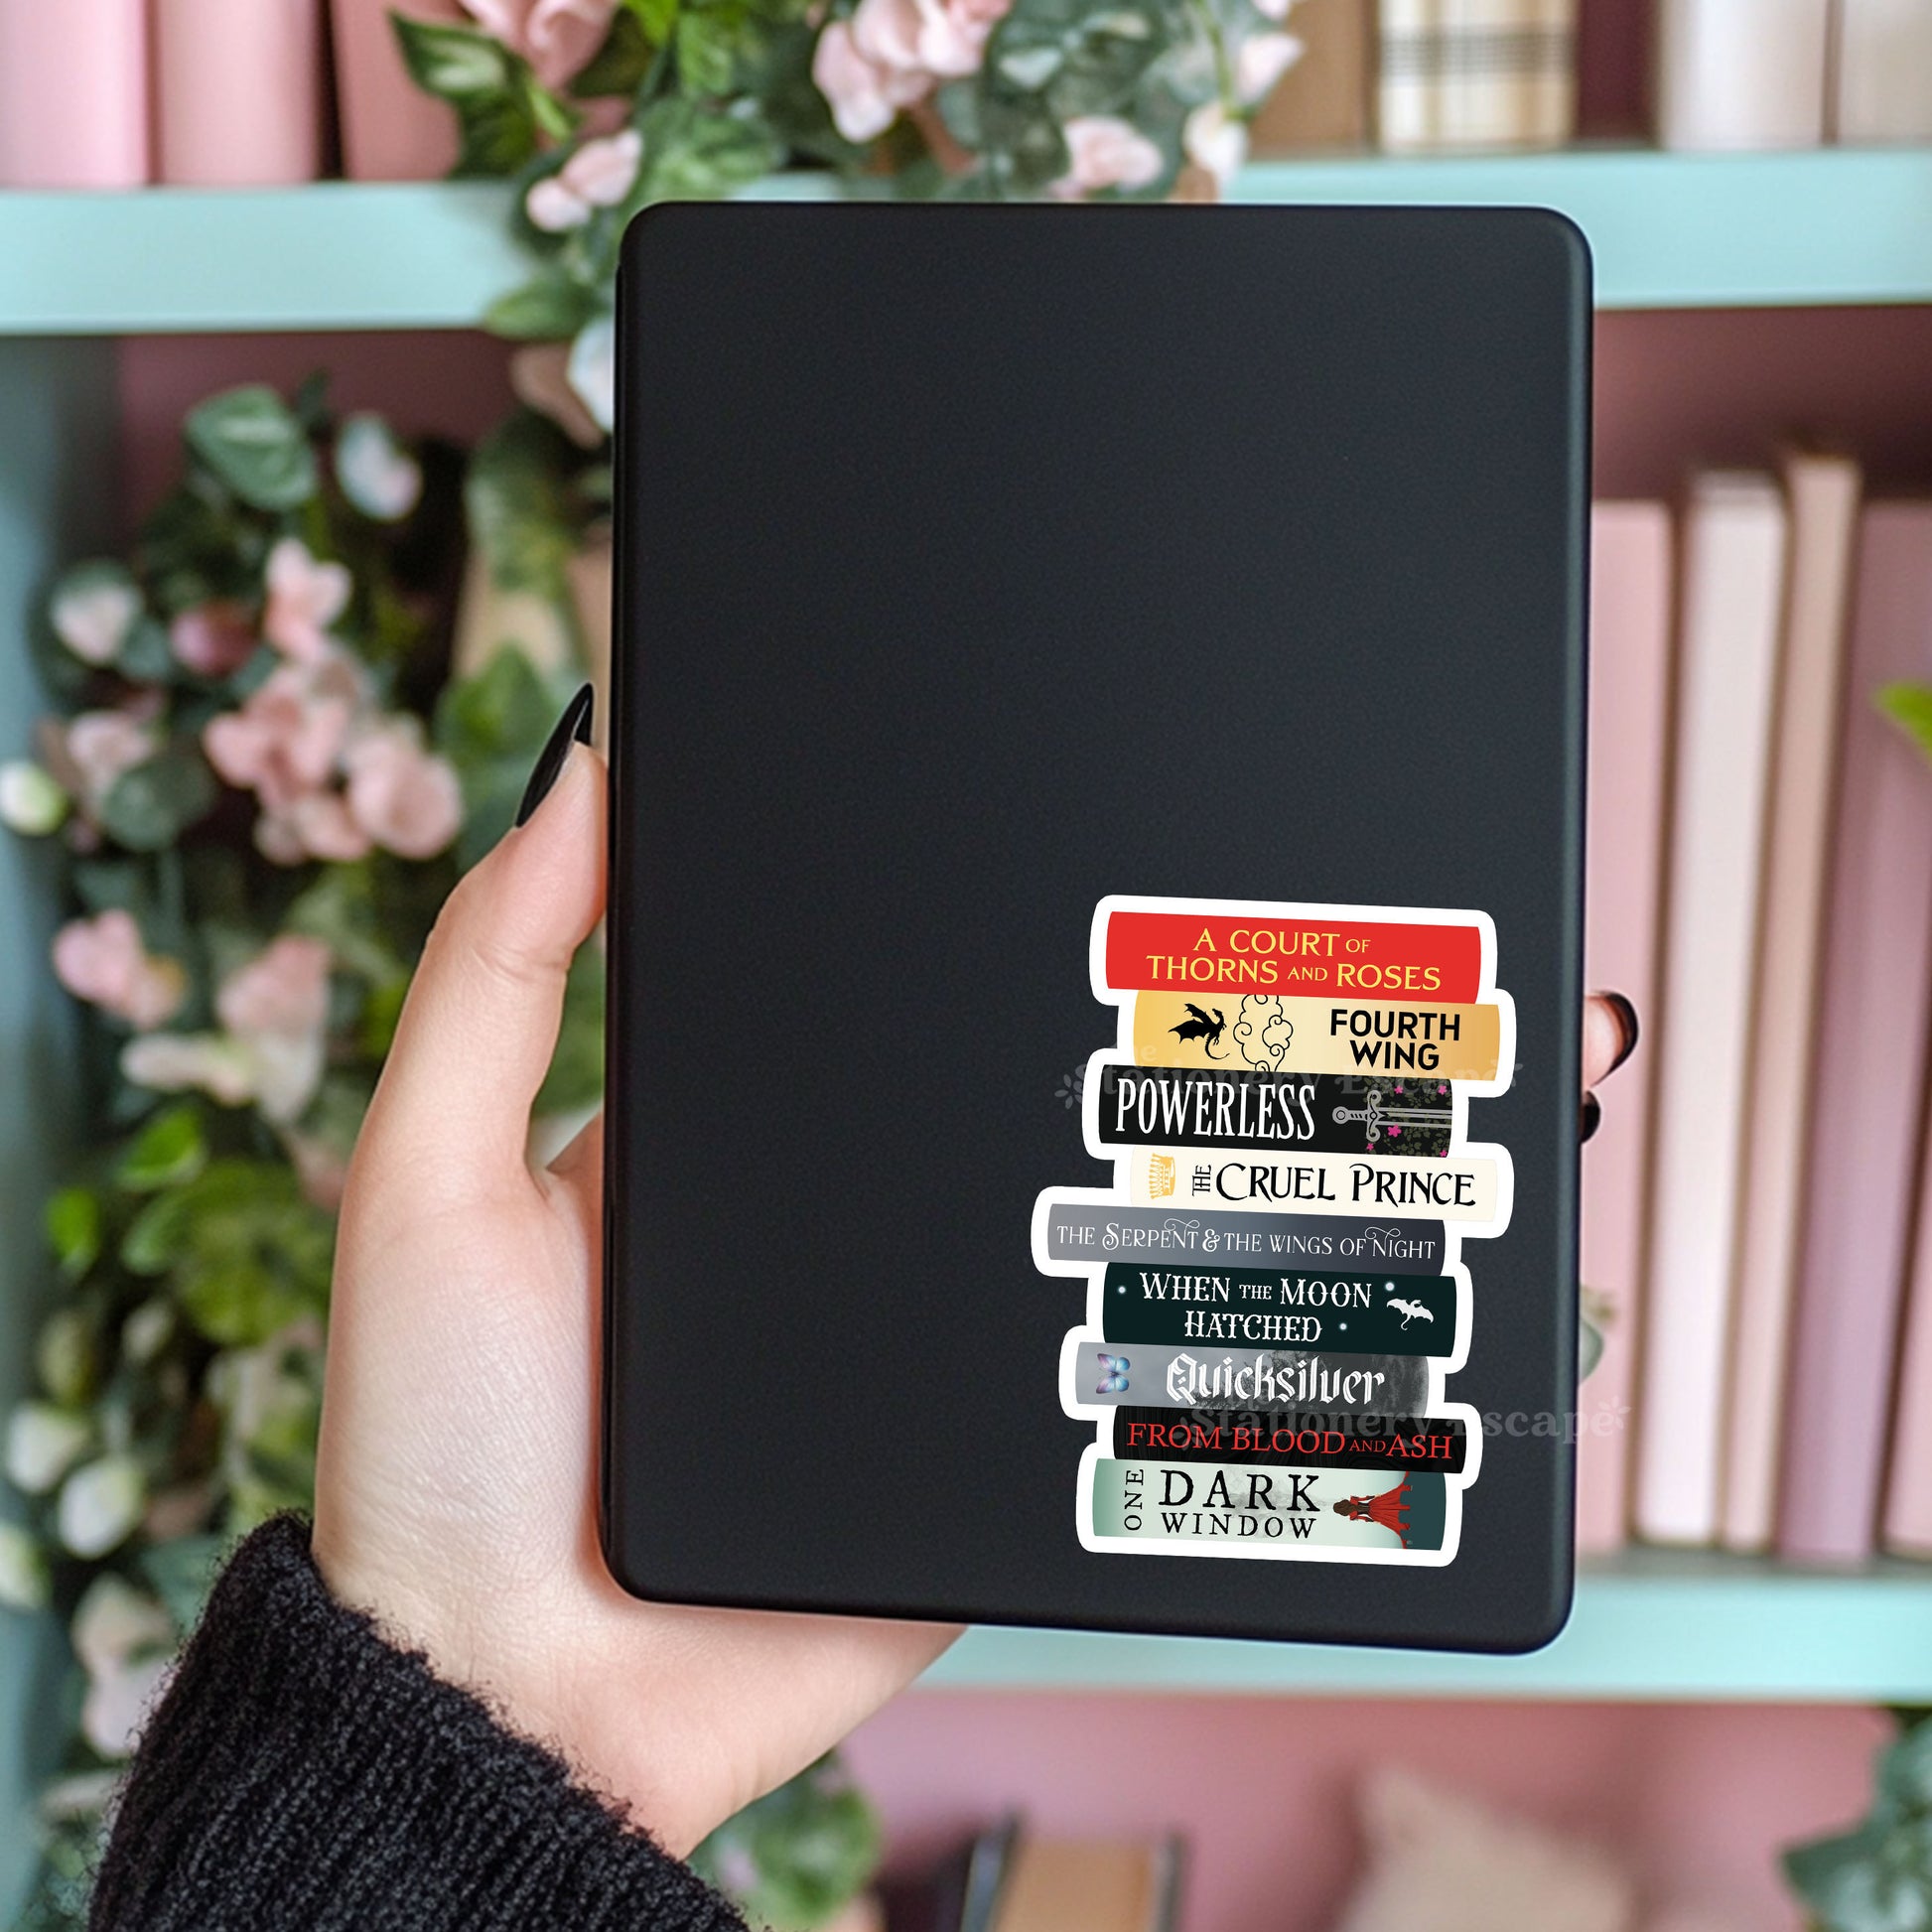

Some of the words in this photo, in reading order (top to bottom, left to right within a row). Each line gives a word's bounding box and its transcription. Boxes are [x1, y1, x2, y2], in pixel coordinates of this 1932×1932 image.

[1192, 927, 1217, 952] A
[1229, 929, 1341, 957] COURT
[1345, 938, 1371, 953] OF
[1146, 954, 1279, 984] THORNS
[1287, 966, 1328, 982] AND
[1336, 963, 1442, 991] ROSES
[1330, 1008, 1460, 1042] FOURTH
[1349, 1037, 1440, 1071] WING
[1115, 1078, 1315, 1141] POWERLESS
[1191, 1165, 1212, 1196] THE
[1215, 1163, 1336, 1203] CRUEL
[1349, 1163, 1476, 1208] PRINCE
[1056, 1225, 1096, 1246] THE
[1101, 1217, 1200, 1251] SERPENT
[1201, 1228, 1221, 1253] &
[1223, 1232, 1262, 1252] THE
[1269, 1234, 1332, 1255] WINGS
[1339, 1238, 1366, 1256] OF
[1363, 1226, 1436, 1259] NIGHT
[1139, 1272, 1231, 1303] WHEN
[1238, 1284, 1272, 1300] THE
[1280, 1278, 1372, 1309] MOON
[1184, 1310, 1322, 1342] HATCHED
[1166, 1352, 1385, 1405] Quicksilver
[1127, 1423, 1223, 1449] FROM
[1231, 1427, 1345, 1454] BLOOD
[1349, 1440, 1386, 1452] AND
[1385, 1434, 1452, 1459] ASH
[1124, 1468, 1144, 1531] ONE
[1158, 1469, 1321, 1515] DARK
[1161, 1512, 1317, 1539] WINDOW
